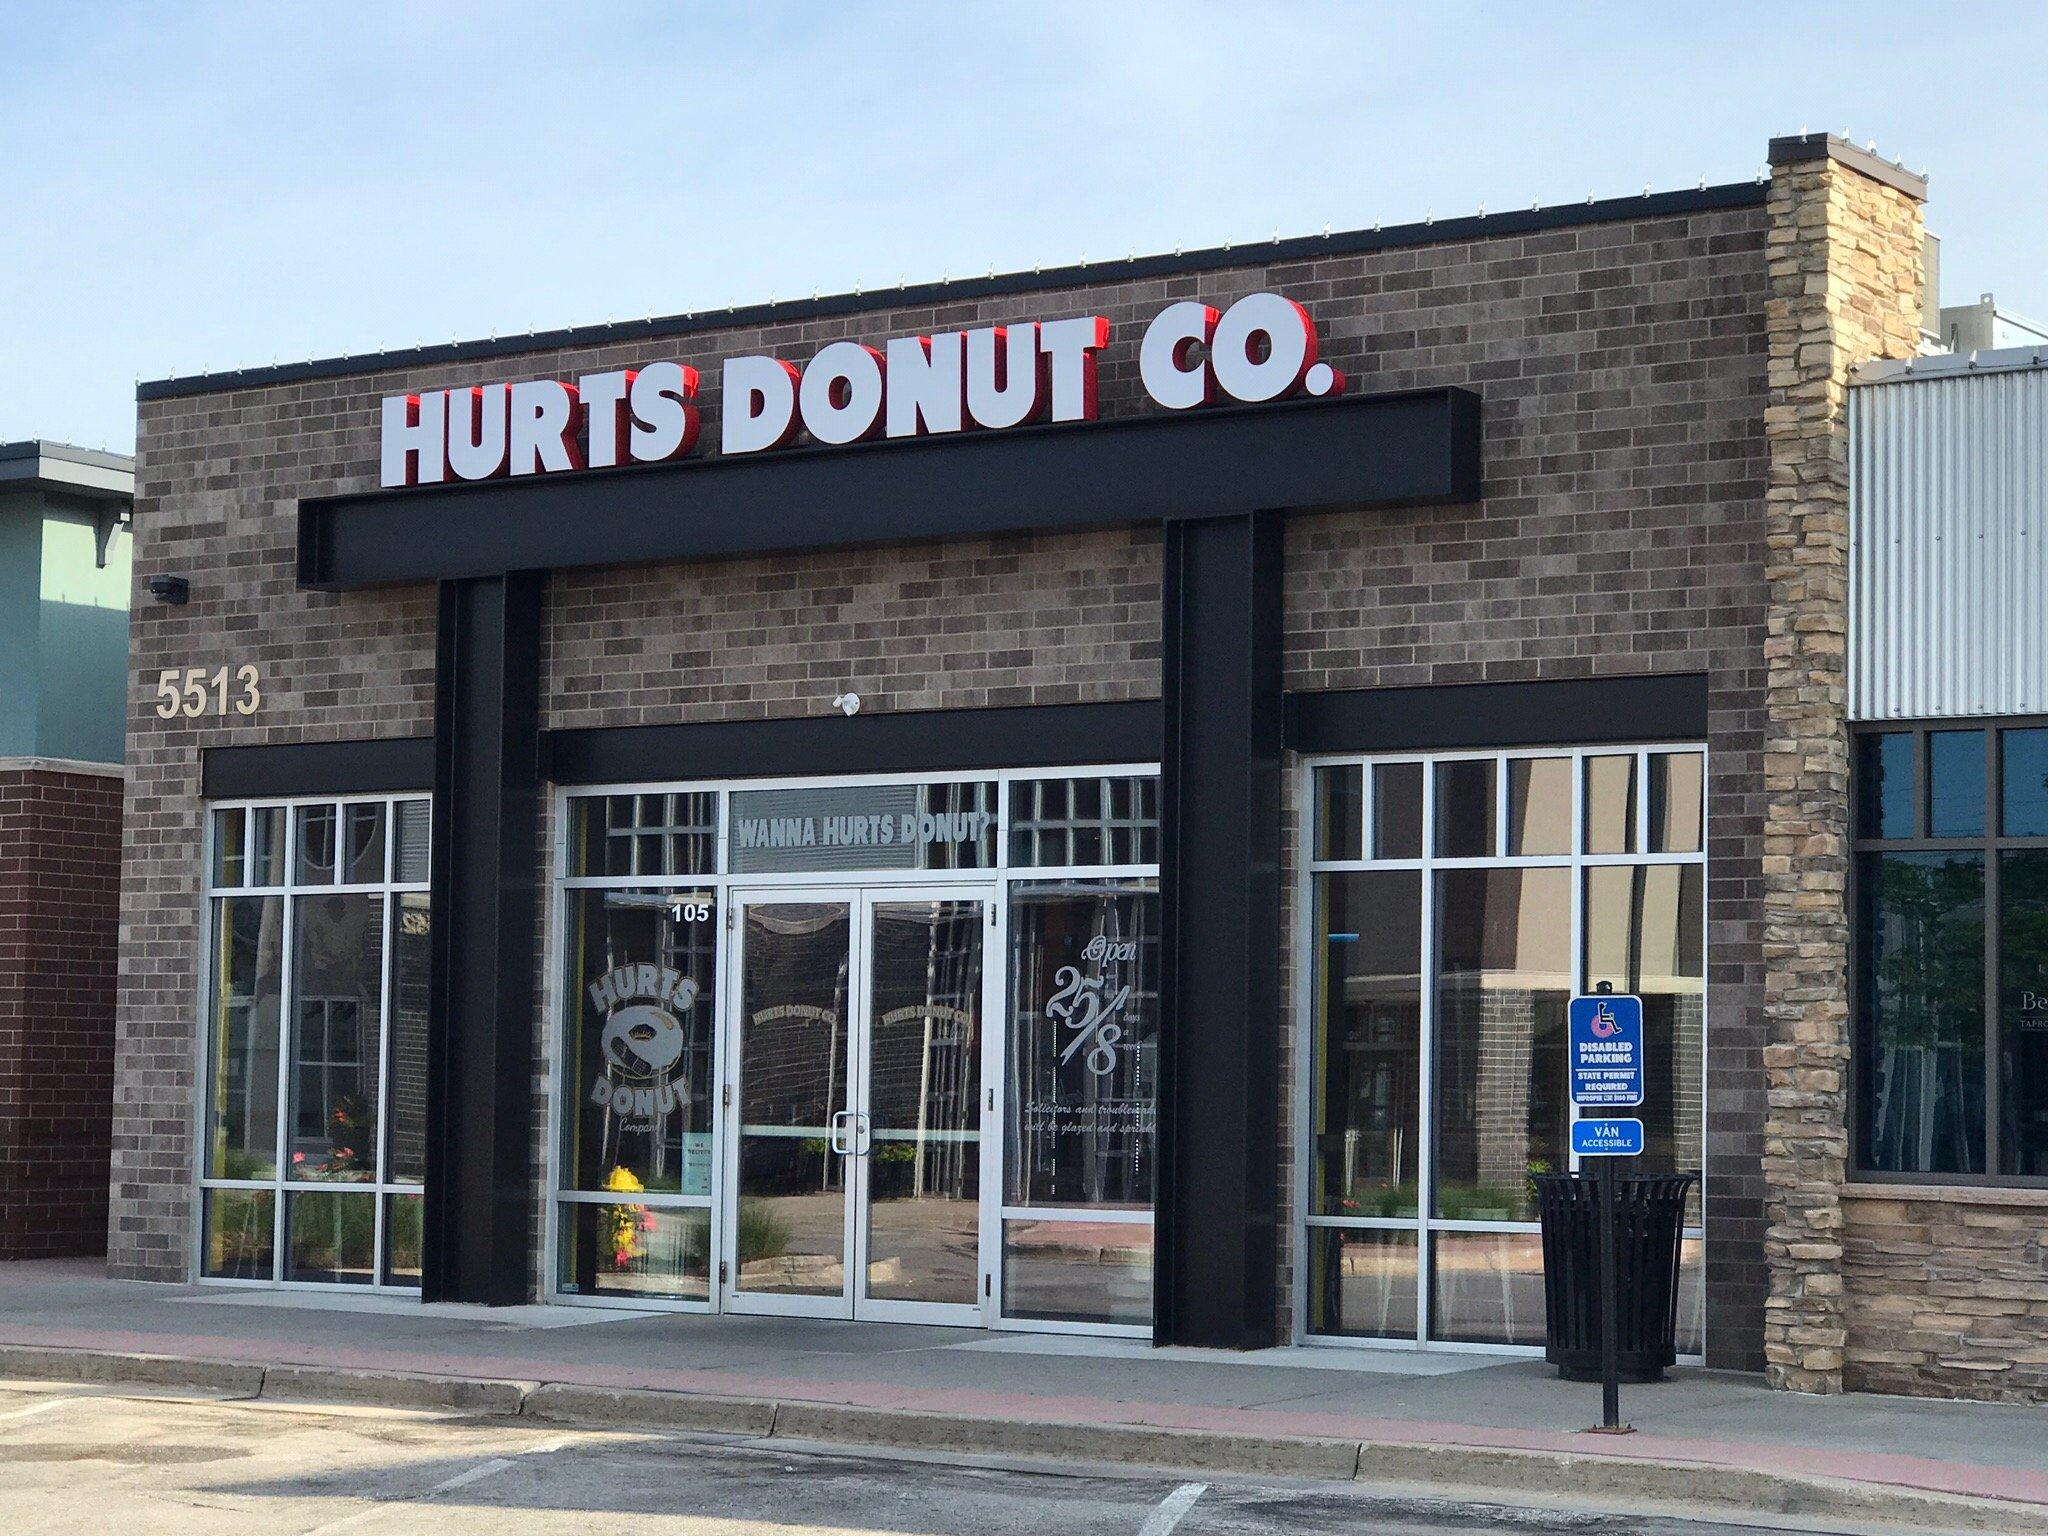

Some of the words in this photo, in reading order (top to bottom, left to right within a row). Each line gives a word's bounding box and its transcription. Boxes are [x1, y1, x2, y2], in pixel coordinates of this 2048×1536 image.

[380, 361, 697, 489] HURTS
[721, 314, 1109, 456] DONUT
[1139, 291, 1345, 409] CO.
[156, 664, 260, 719] 5513
[738, 817, 815, 848] WANNA
[823, 814, 895, 846] HURTS
[901, 811, 990, 843] DONUT?
[671, 904, 709, 923] 105
[1081, 935, 1136, 967] Open
[588, 961, 699, 1016] HURTS
[752, 1005, 785, 1026] HURTS
[786, 1004, 823, 1020] DONUT
[882, 1005, 916, 1027] HURTS
[916, 1005, 954, 1020] DONUT
[1579, 1042, 1633, 1053] DISABLED
[1580, 1053, 1633, 1064] PARKING
[1577, 1071, 1602, 1080] STATE
[1603, 1071, 1635, 1080] PERMIT
[591, 1073, 691, 1118] DONUT
[1585, 1082, 1628, 1091] REQUIRED
[1024, 1101, 1072, 1114] Solicitors
[1075, 1102, 1096, 1114] and
[619, 1117, 662, 1136] Compan
[1024, 1120, 1045, 1132] will
[1061, 1121, 1096, 1135] glazed
[1097, 1122, 1117, 1133] and
[1594, 1126, 1619, 1137] VAN
[1581, 1139, 1633, 1148] ACCESSIBLE
